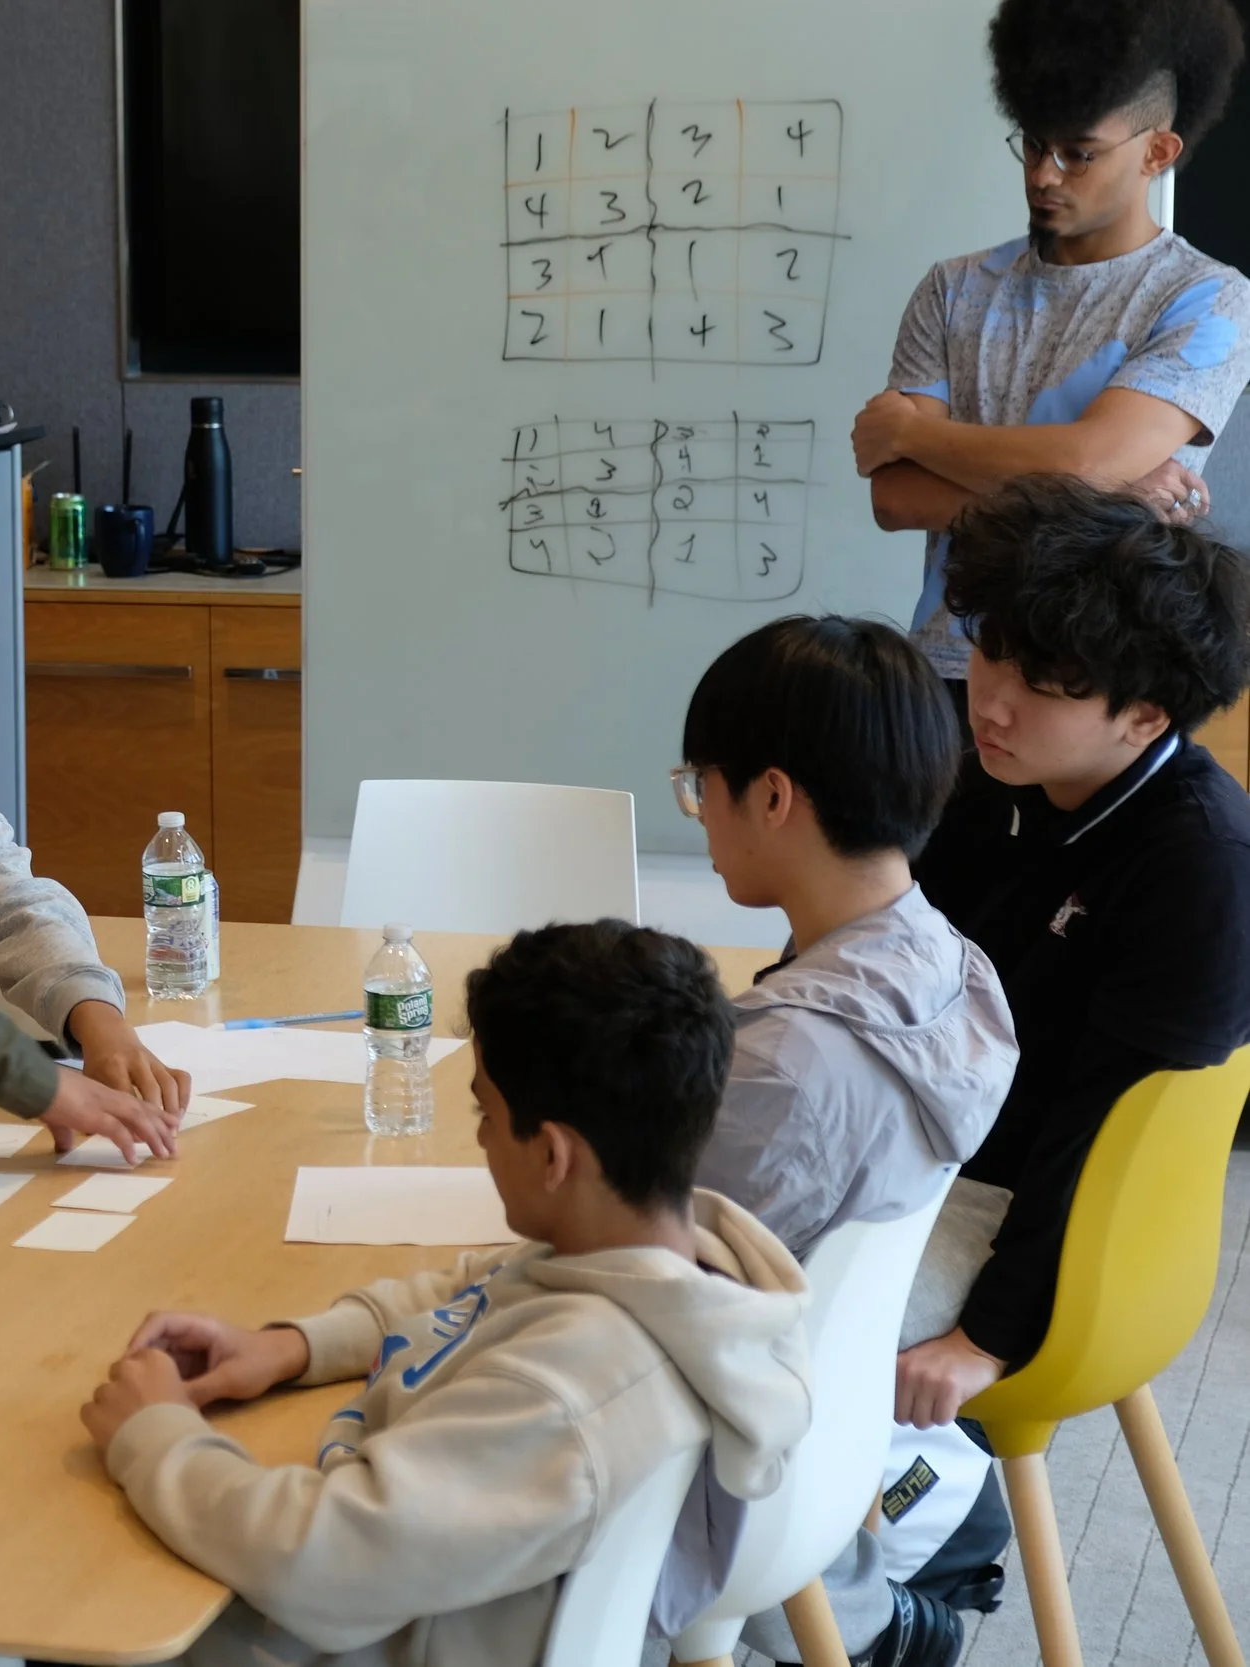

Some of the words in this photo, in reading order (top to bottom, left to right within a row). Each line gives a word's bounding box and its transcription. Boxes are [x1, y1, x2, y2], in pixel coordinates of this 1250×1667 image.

[536, 133, 543, 171] 1
[593, 128, 634, 149] 2
[681, 124, 713, 158] 3
[787, 119, 815, 158] 4
[525, 193, 549, 229] 4
[600, 191, 627, 225] 3
[682, 180, 712, 205] 2
[777, 186, 784, 213] 1
[532, 258, 553, 290] 3
[688, 240, 699, 302] 1
[776, 248, 800, 280] 2
[521, 310, 549, 345] 2
[599, 309, 606, 347] 1
[690, 314, 717, 348] 4
[763, 310, 794, 352] 3
[594, 421, 616, 448] 4
[595, 458, 618, 482] 3
[678, 444, 692, 473] 4
[753, 444, 772, 468] 1
[524, 504, 545, 526] 3
[753, 489, 770, 518] 4
[530, 538, 552, 573] 4
[674, 533, 696, 564] 1
[755, 542, 778, 577] 3
[397, 994, 428, 1013] Poland
[398, 1006, 430, 1025] Spring
